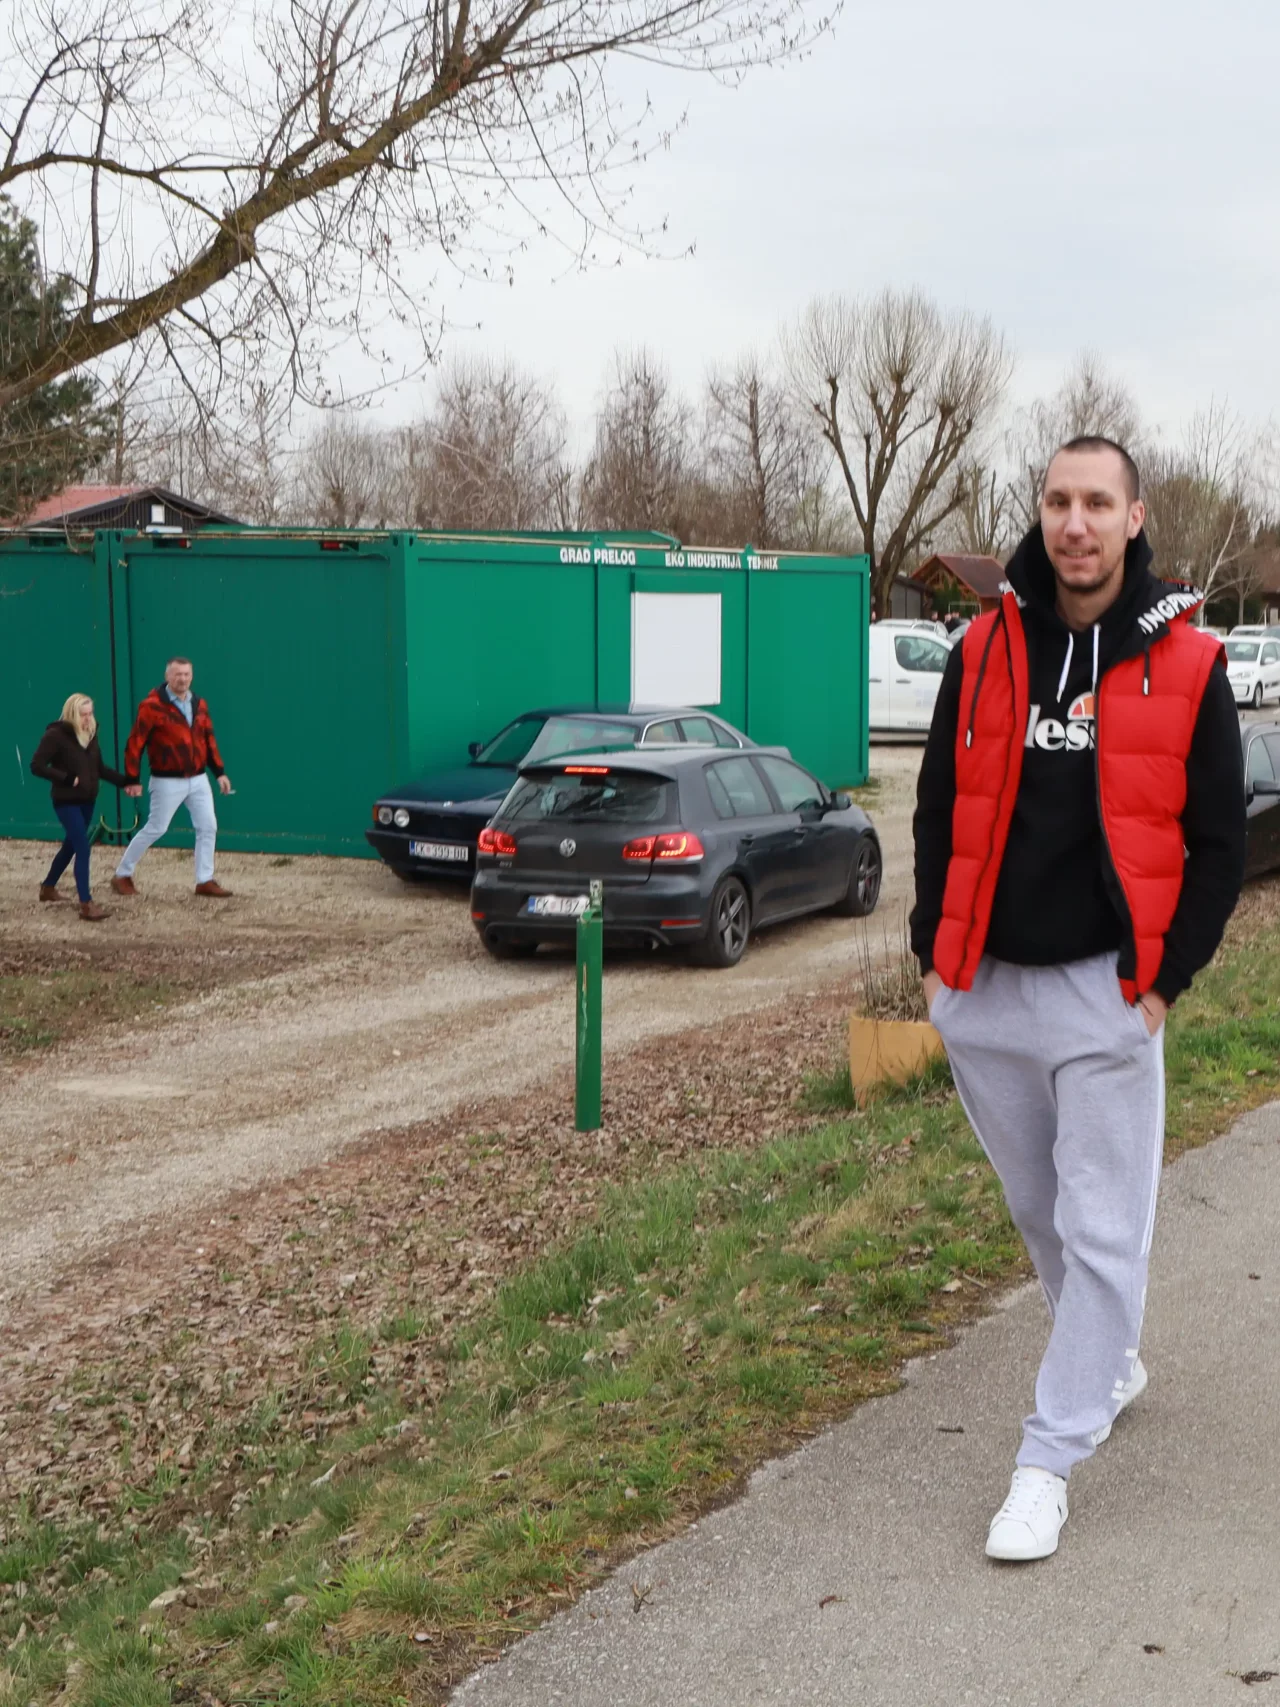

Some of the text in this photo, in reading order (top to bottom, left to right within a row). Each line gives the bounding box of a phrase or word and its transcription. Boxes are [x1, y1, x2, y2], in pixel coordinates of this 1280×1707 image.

[560, 547, 636, 566] GRAD PRELOG
[665, 552, 778, 570] EKO INDUSTRIJA TEHNIX
